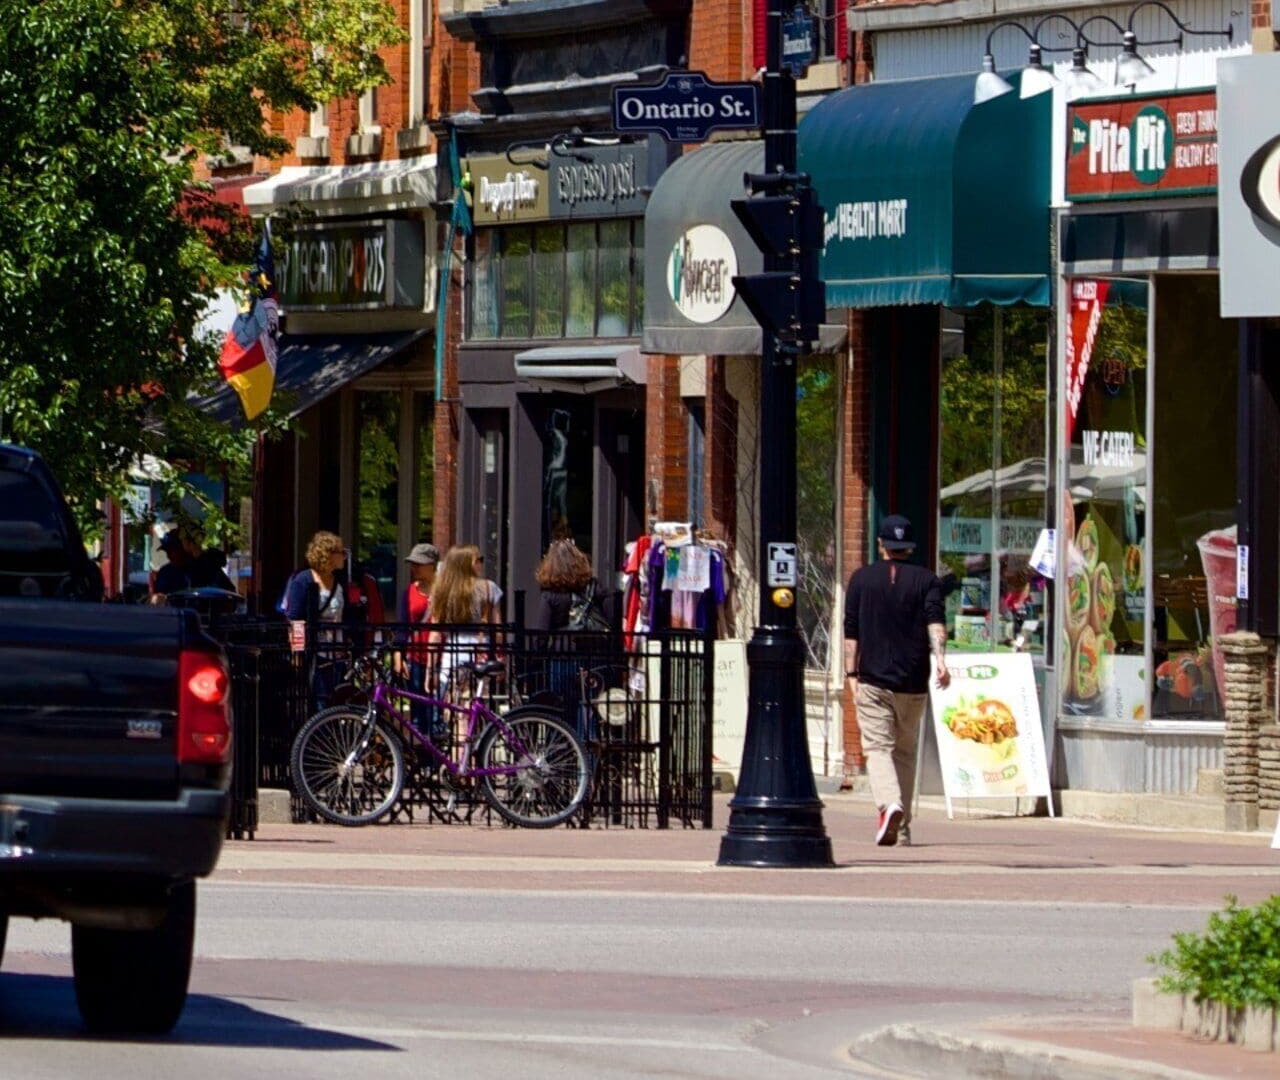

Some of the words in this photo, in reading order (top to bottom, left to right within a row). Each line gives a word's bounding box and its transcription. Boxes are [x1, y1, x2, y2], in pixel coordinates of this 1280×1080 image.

[621, 96, 715, 120] Ontario
[720, 94, 751, 118] St.
[1072, 127, 1087, 143] The
[1088, 118, 1131, 174] Pita
[1136, 114, 1166, 171] Pit
[1175, 144, 1202, 168] HEALTHY
[1204, 142, 1218, 166] EAT
[558, 164, 608, 205] espresso
[608, 154, 637, 201] post
[839, 202, 877, 242] HEALTH
[878, 199, 908, 239] MART
[1083, 430, 1100, 465] WE
[1101, 431, 1135, 467] CATER!
